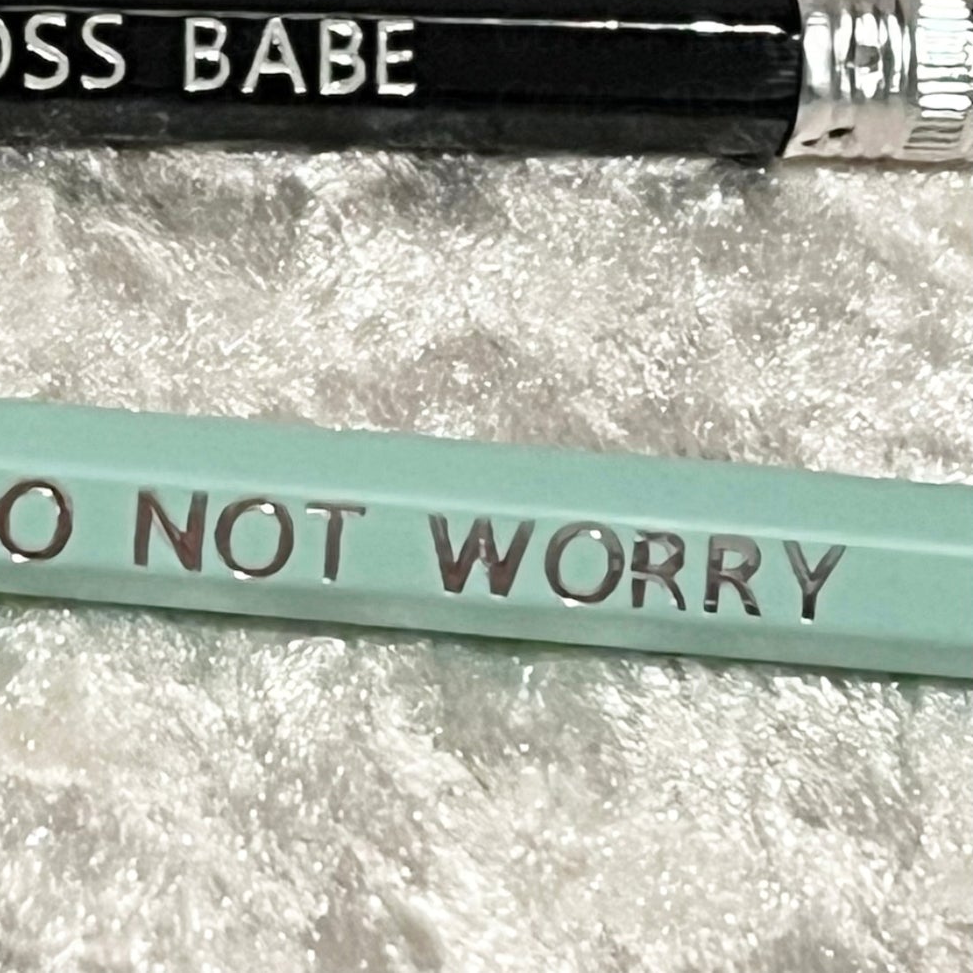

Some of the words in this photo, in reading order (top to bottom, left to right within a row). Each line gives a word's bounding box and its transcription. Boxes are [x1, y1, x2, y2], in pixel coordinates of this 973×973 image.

[184, 16, 417, 96] BABE
[133, 488, 366, 584] NOT
[428, 513, 846, 625] WORRY
